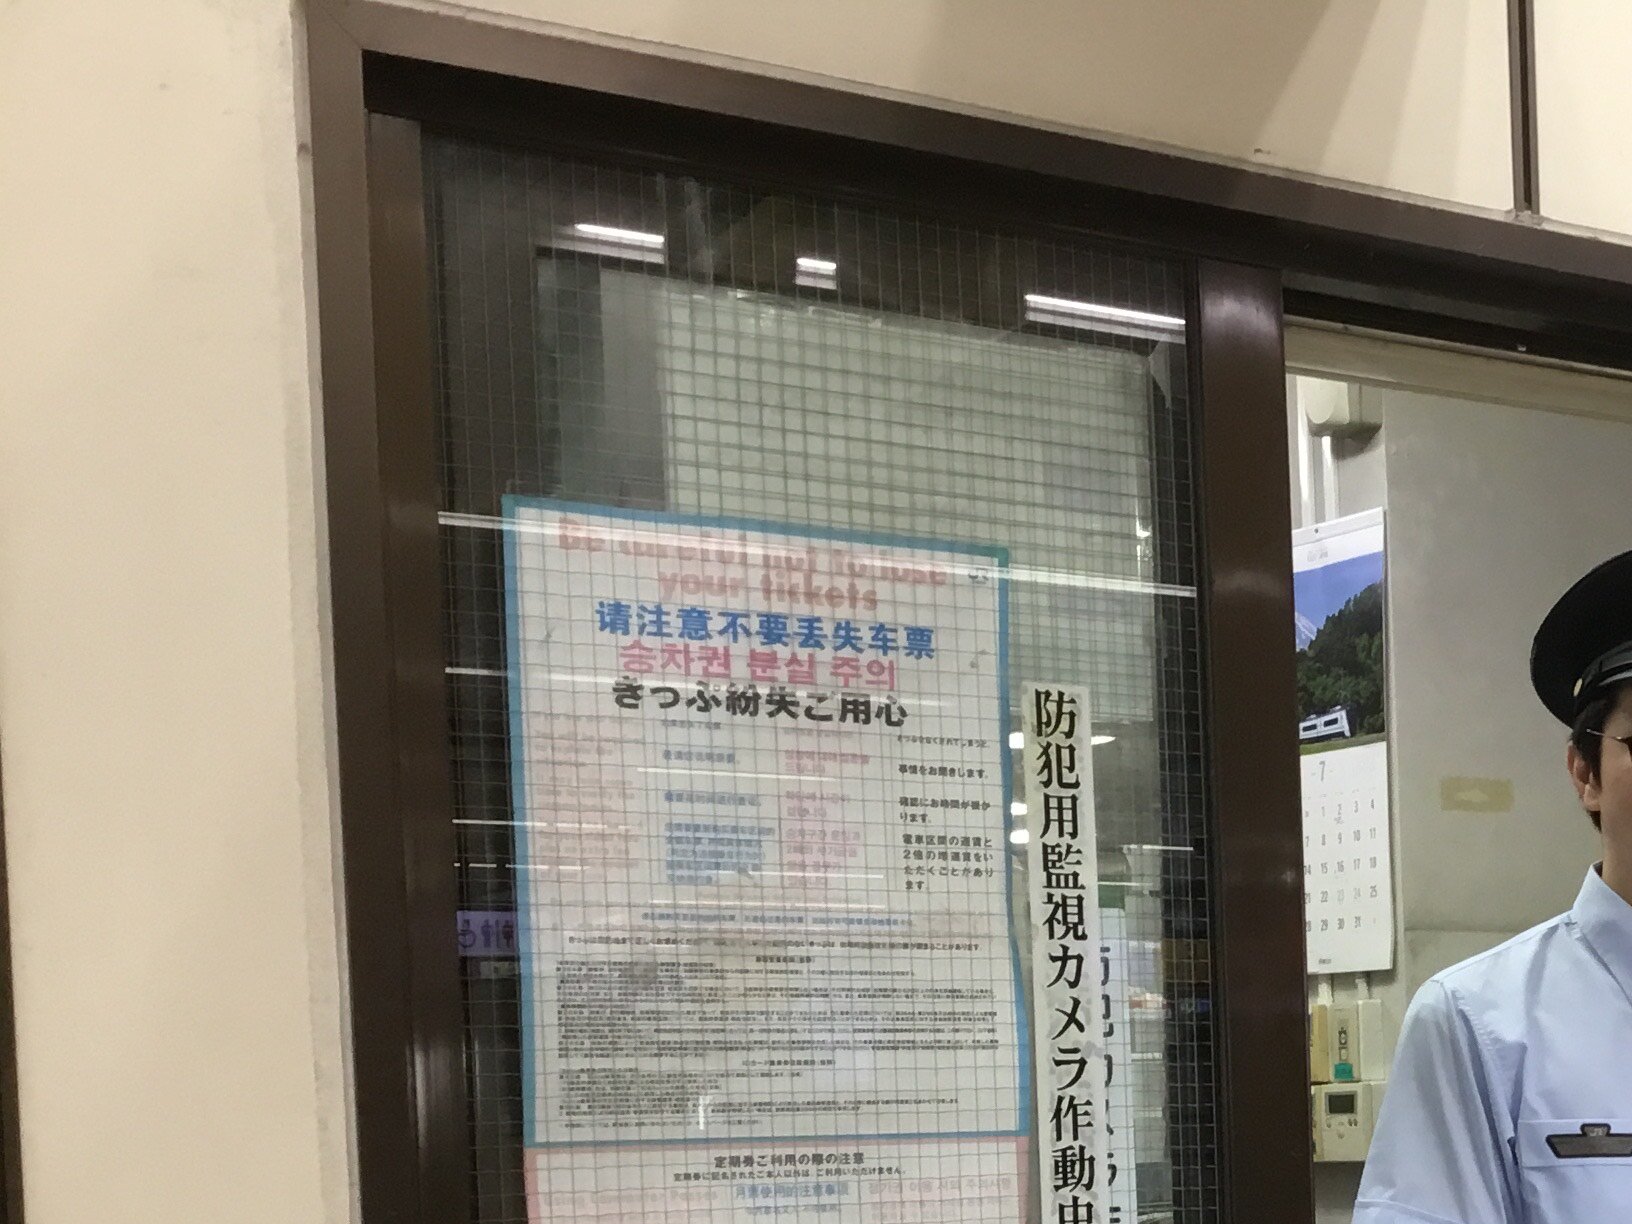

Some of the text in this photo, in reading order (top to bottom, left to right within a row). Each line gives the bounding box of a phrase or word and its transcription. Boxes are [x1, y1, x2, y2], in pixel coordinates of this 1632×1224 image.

[660, 571, 878, 611] your tickets
[595, 600, 936, 660] 请注意不要丢失车票
[746, 648, 817, 685] 분실
[830, 655, 896, 692] 주의
[1319, 760, 1327, 782] 7
[714, 1153, 865, 1168] 定期券ご利用の際の注意
